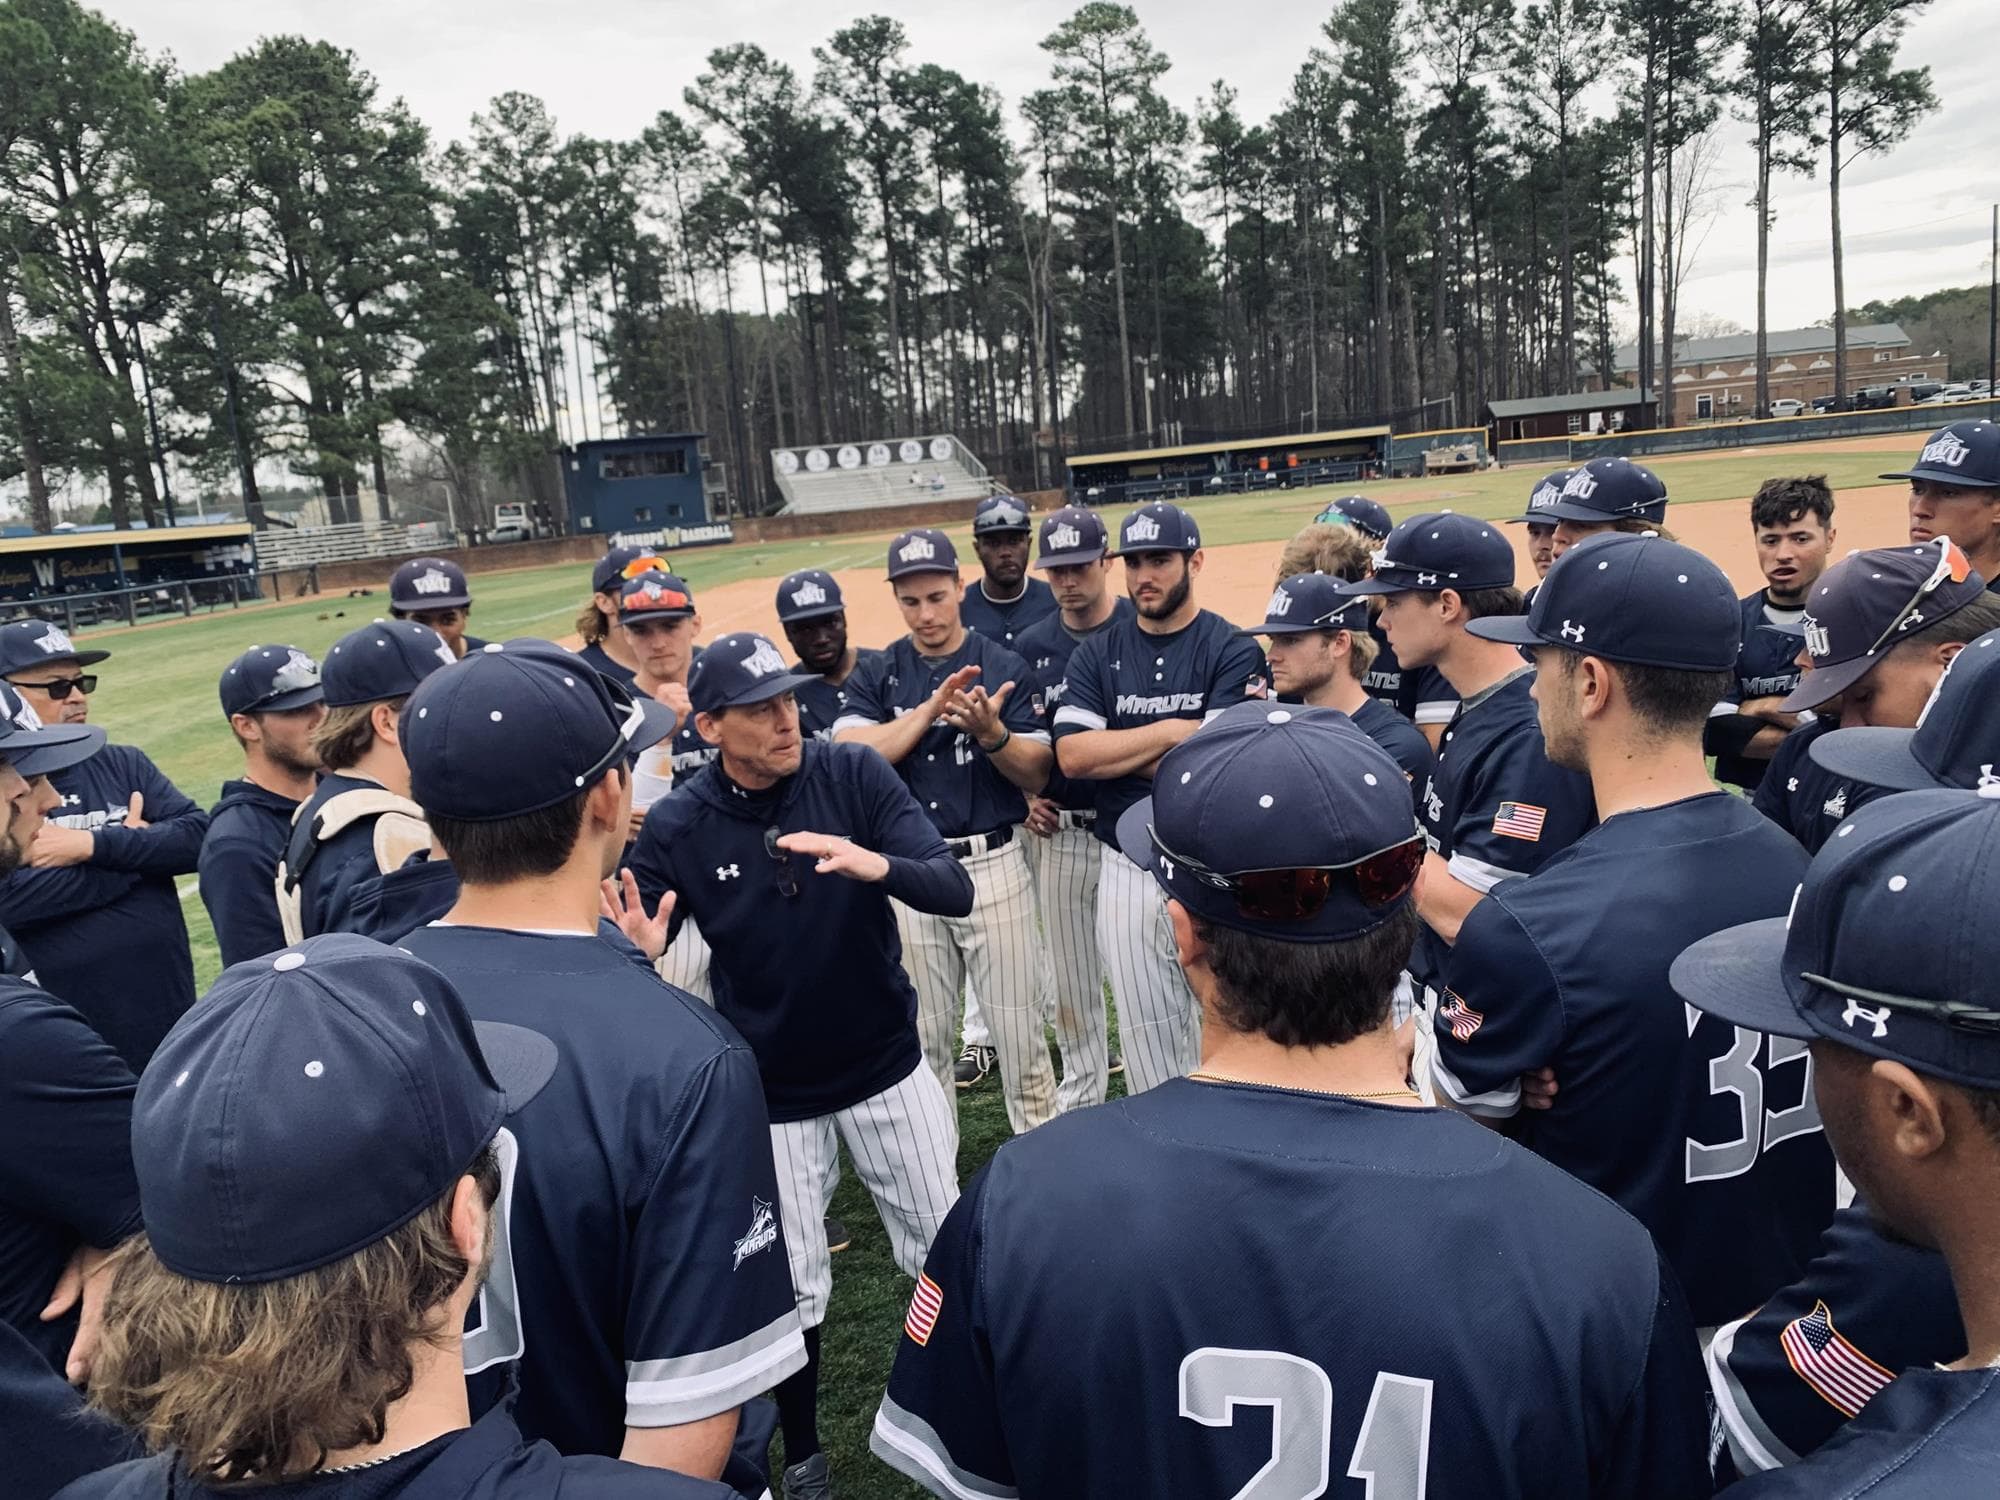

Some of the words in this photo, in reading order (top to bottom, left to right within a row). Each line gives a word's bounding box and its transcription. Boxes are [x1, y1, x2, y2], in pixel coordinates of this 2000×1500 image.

[681, 525, 733, 543] BASEBALL
[32, 558, 55, 587] W
[1115, 692, 1205, 717] MARLINS
[1178, 1346, 1434, 1500] 21
